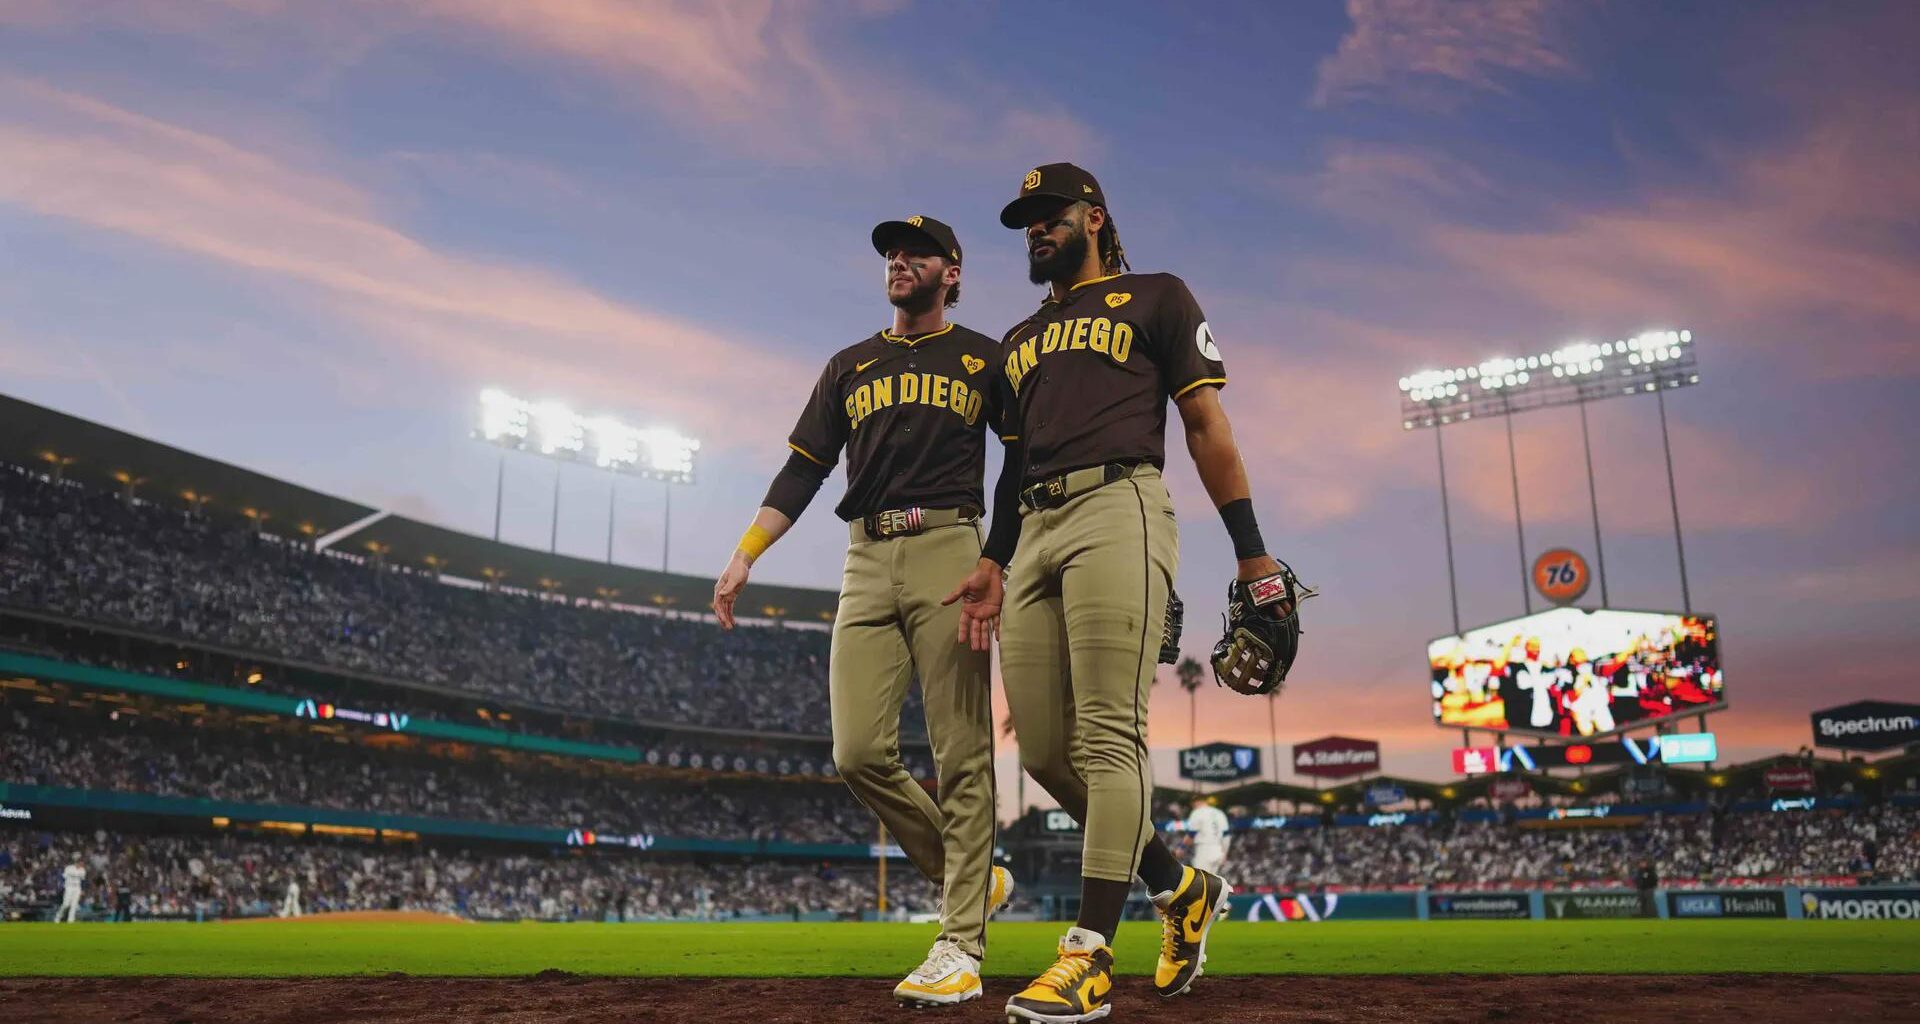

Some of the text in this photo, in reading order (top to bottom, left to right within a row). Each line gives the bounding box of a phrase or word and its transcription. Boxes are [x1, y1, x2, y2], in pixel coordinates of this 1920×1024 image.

[1111, 295, 1123, 304] PS
[1041, 317, 1133, 363] DIEGO
[967, 360, 978, 370] PS
[845, 372, 983, 430] SAN DIEGO
[1049, 482, 1062, 496] 23
[1546, 560, 1576, 587] 76
[1820, 716, 1914, 738] Spectrum
[1184, 749, 1232, 769] blue
[1681, 896, 1776, 913] UCLA Health
